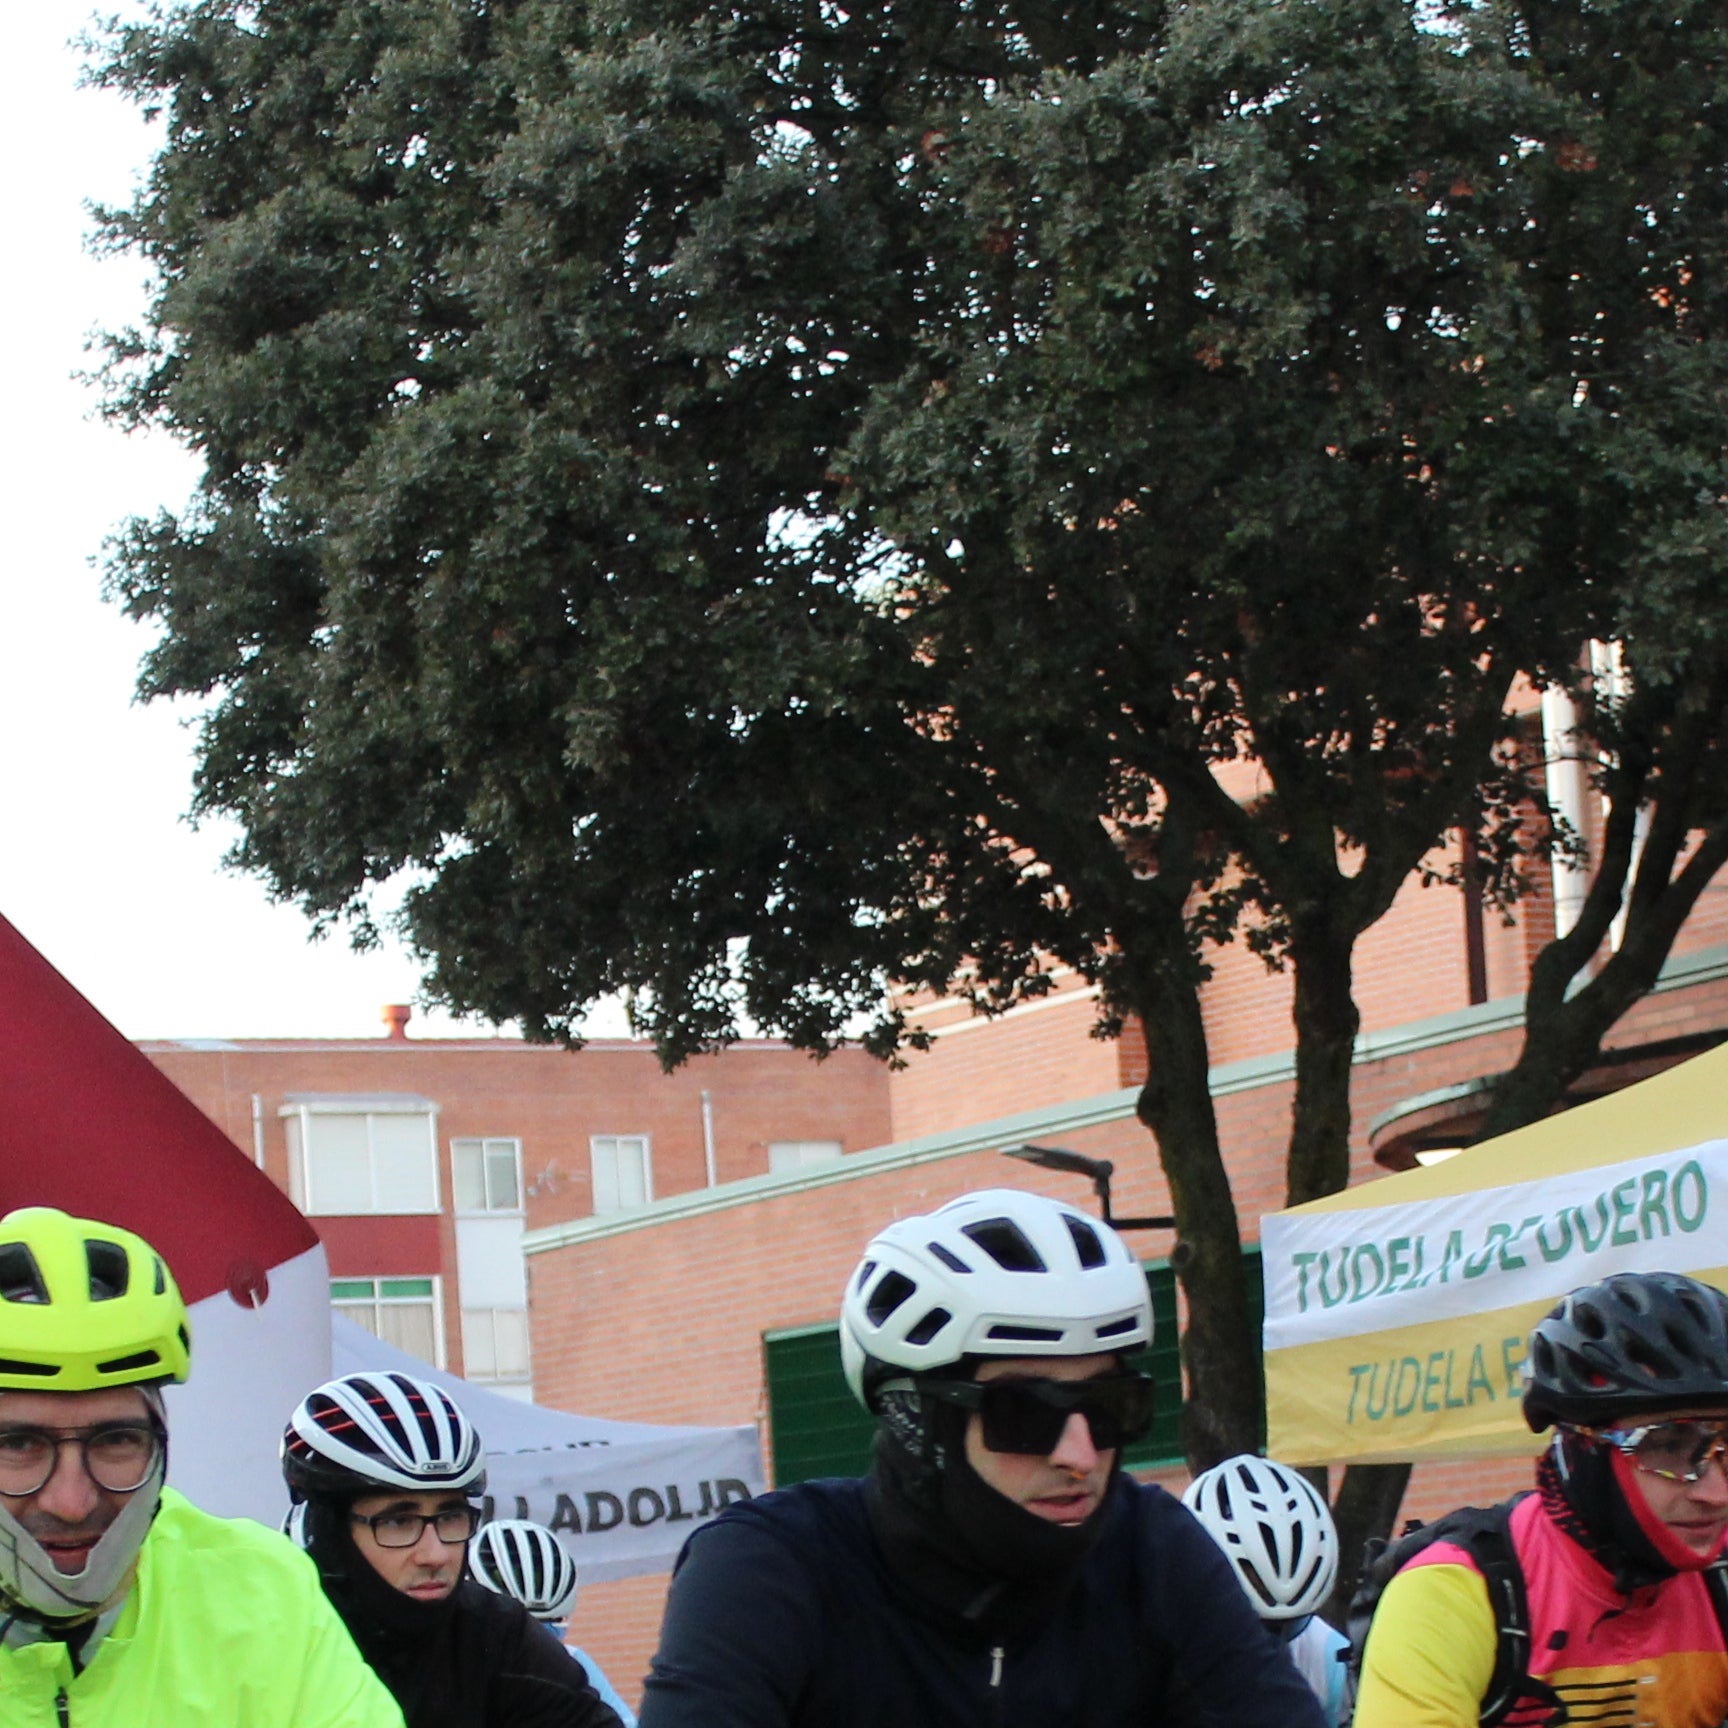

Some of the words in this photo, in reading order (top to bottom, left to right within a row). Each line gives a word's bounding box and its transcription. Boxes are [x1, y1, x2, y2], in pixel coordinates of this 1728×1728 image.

[1290, 1229, 1460, 1313] TUDELA
[1346, 1344, 1496, 1426] TUDELA
[1501, 1336, 1535, 1398] E
